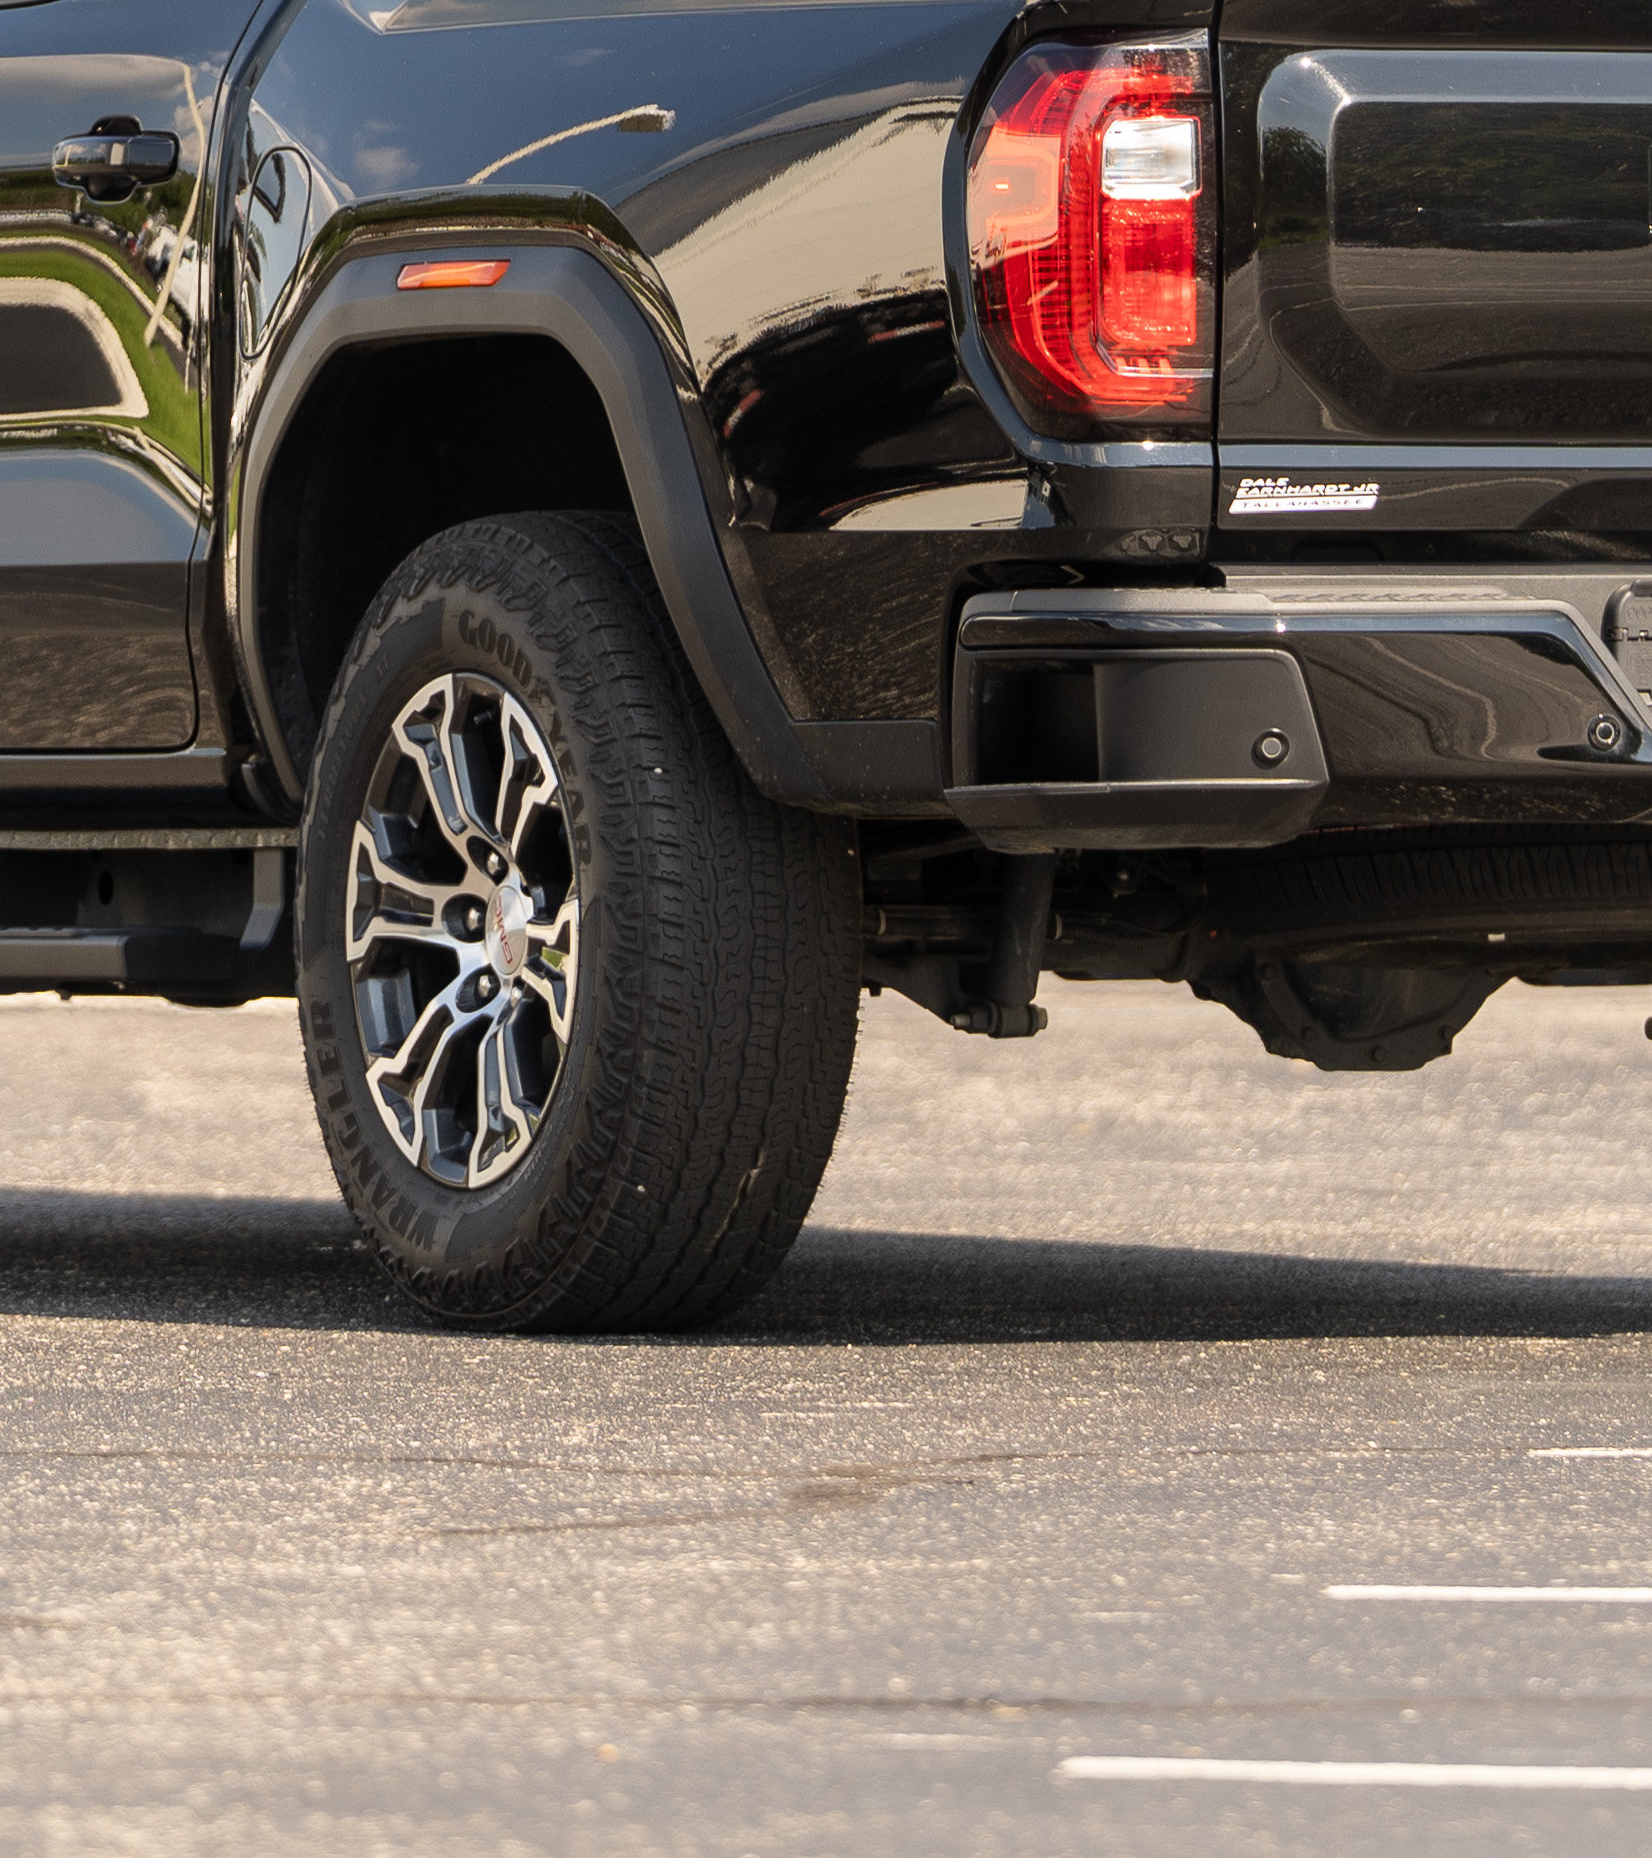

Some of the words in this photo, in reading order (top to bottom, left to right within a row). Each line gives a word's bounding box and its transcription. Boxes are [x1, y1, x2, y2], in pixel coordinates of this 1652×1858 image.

[1236, 484, 1350, 497] EARNHARDT
[1240, 477, 1289, 487] DALE
[1243, 498, 1364, 508] TALLAHASSEE
[458, 609, 593, 866] GOODYEAR
[493, 895, 514, 965] GMC
[310, 998, 440, 1252] WRANGLER
